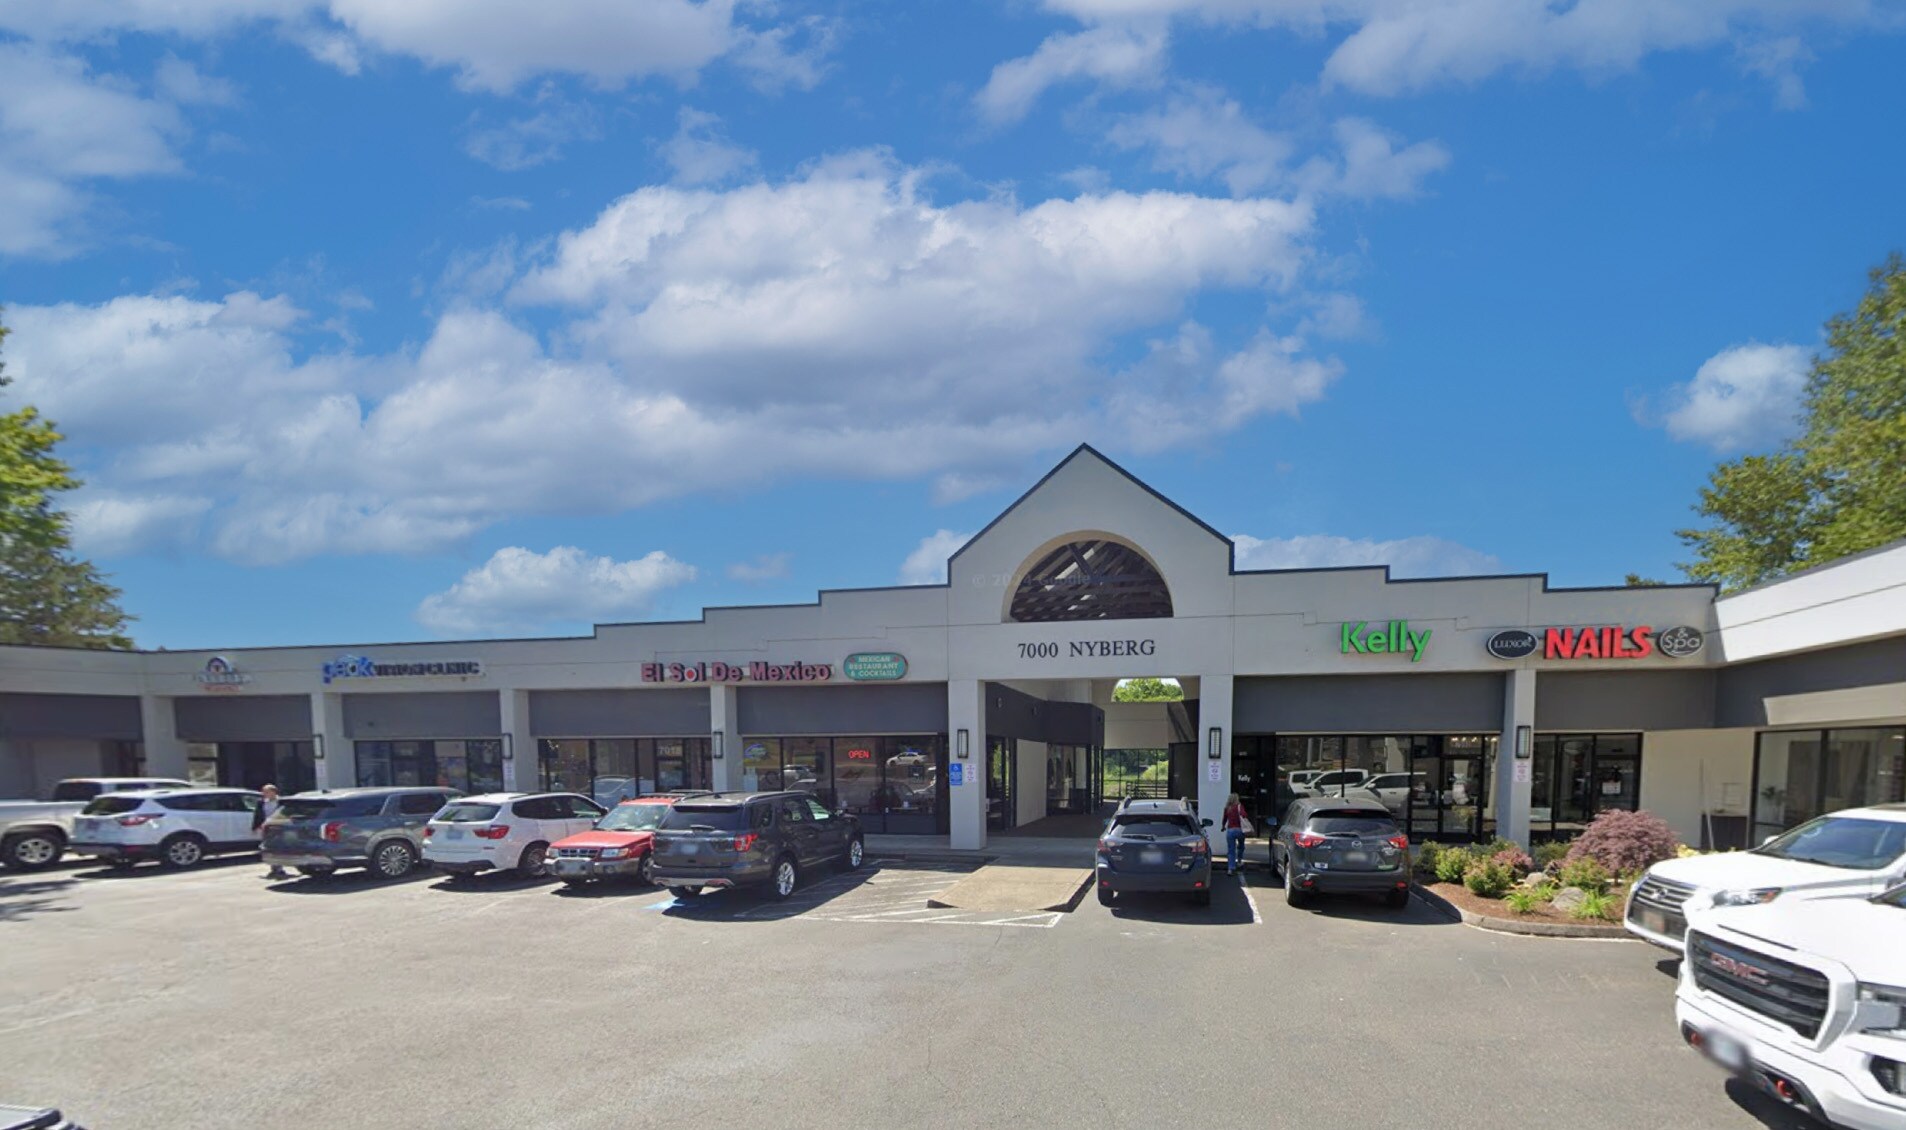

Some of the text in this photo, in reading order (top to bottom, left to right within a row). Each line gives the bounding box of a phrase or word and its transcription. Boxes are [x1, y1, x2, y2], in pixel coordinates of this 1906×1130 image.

[1017, 639, 1156, 659] 7000 NYBERG
[1341, 619, 1433, 663] Kelly
[1543, 626, 1653, 660] NAILS
[641, 660, 832, 682] El Sol De Mexico
[848, 749, 870, 759] OPEN
[1710, 951, 1770, 986] GMC
